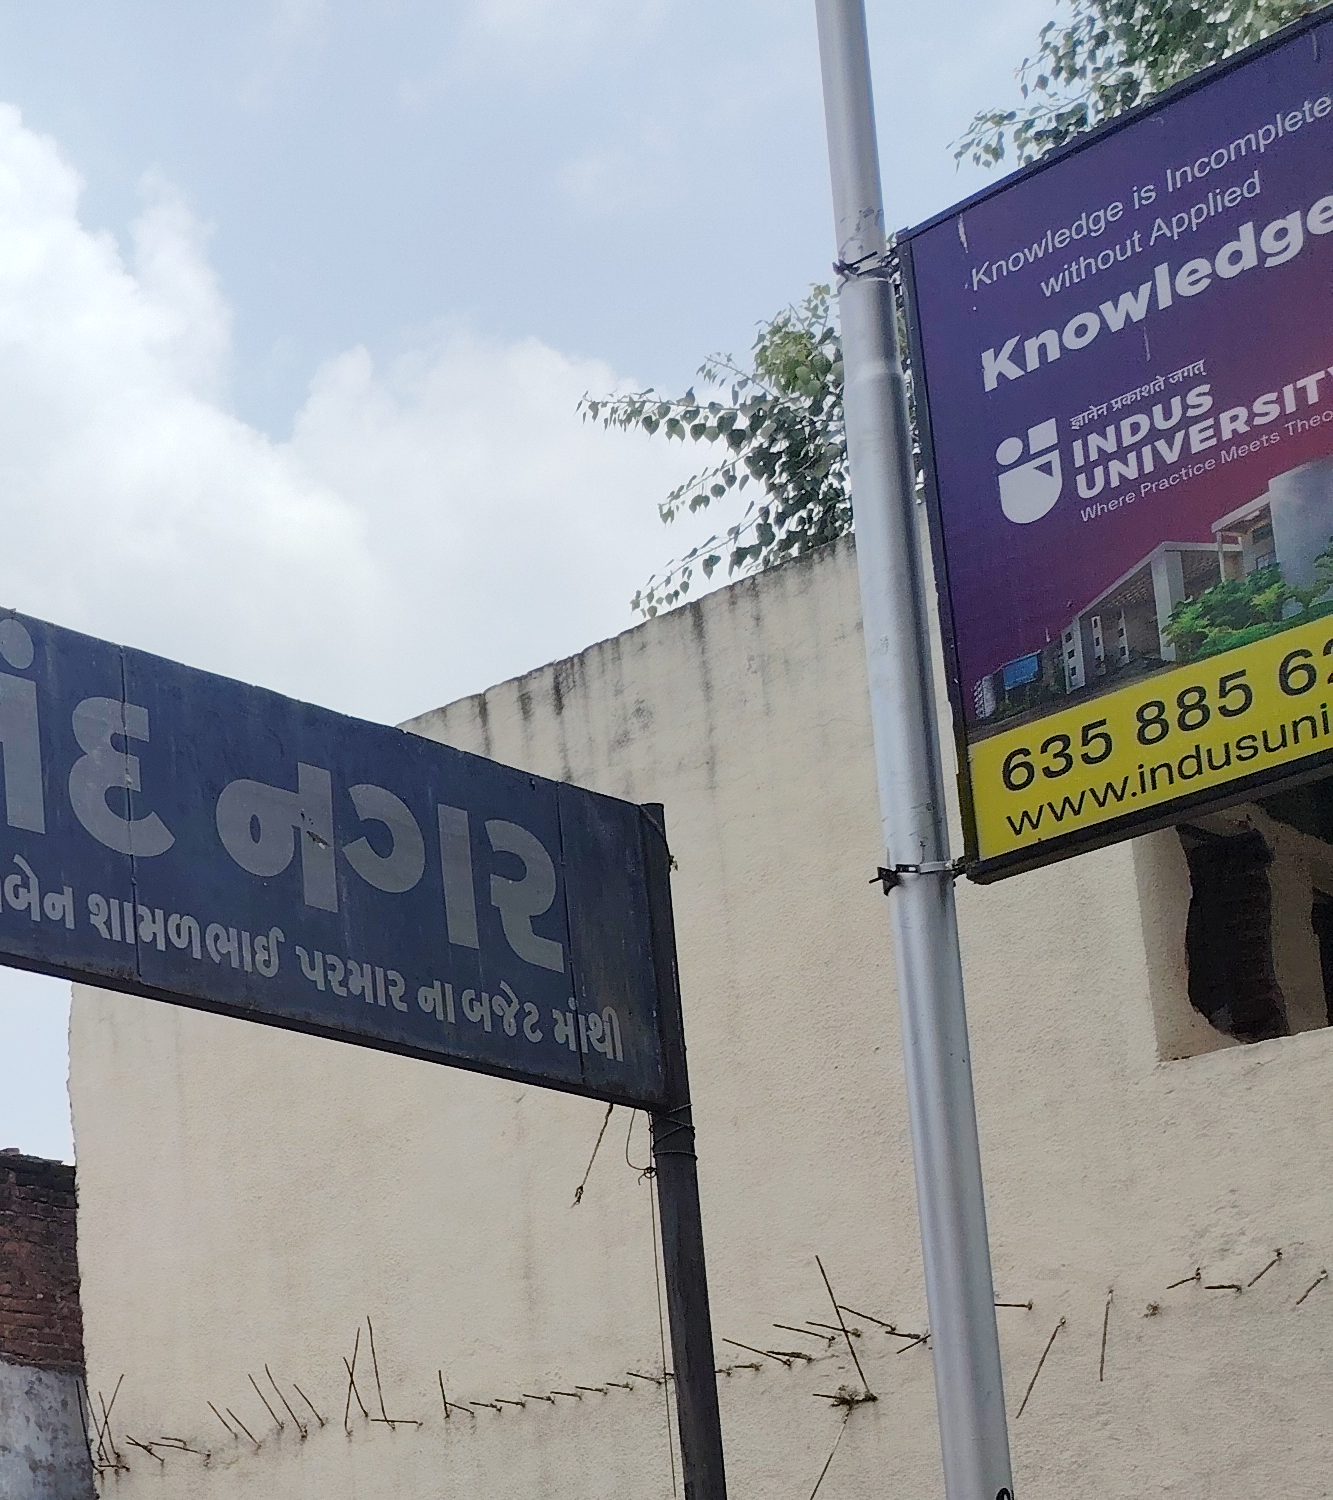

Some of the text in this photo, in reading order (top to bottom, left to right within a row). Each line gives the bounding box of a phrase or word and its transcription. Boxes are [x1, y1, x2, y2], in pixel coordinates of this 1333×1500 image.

[971, 95, 1333, 292] Knowledge is Incomplete
[1041, 170, 1262, 298] without Applied
[981, 194, 1333, 393] Knowledge
[1070, 359, 1207, 431] ज्ञानेन प्रकाशते जगत्
[1072, 383, 1213, 469] INDUS
[1075, 367, 1333, 500] UNIVERSIT
[1081, 410, 1333, 522] Where Practice Meets Theo
[1001, 718, 1114, 792] 635
[1136, 669, 1253, 746] 885
[1006, 702, 1331, 836] www.indusuni
[216, 764, 564, 973] નગર
[89, 893, 286, 978] શામળભાઈ
[295, 945, 409, 1013] પરમાર
[553, 998, 625, 1062] માંથી
